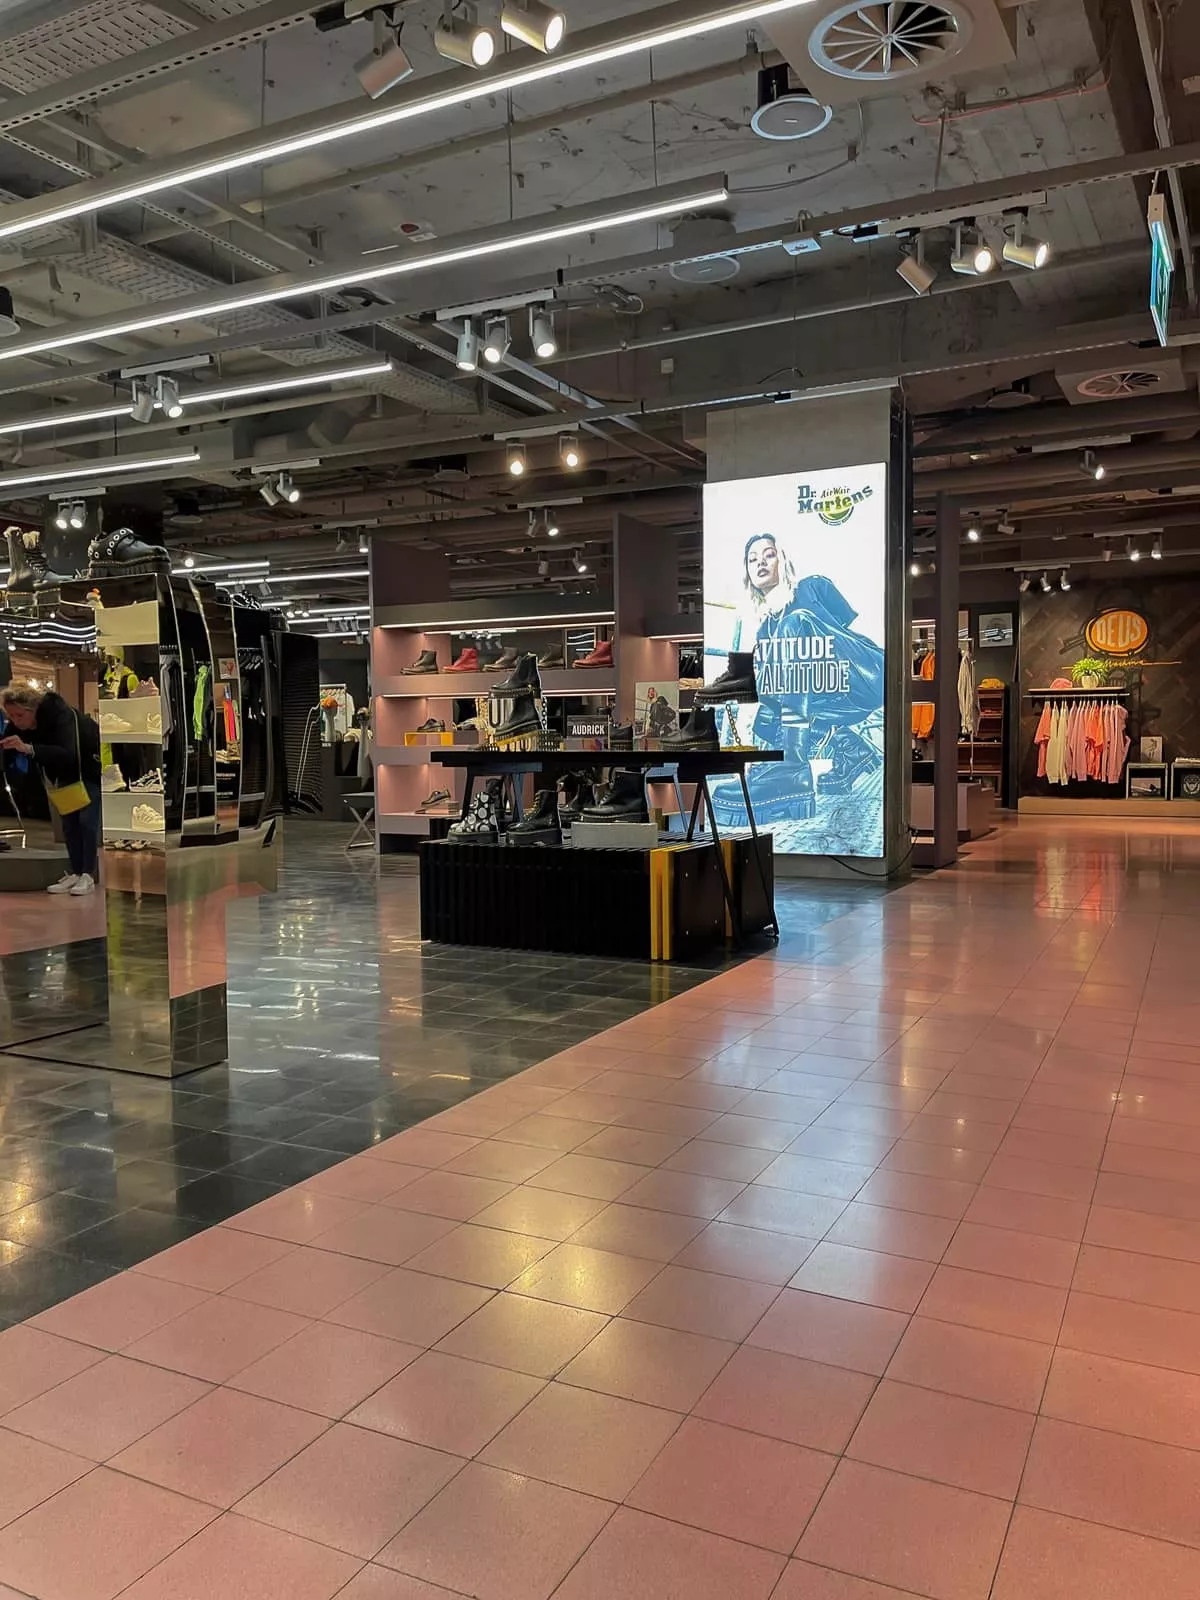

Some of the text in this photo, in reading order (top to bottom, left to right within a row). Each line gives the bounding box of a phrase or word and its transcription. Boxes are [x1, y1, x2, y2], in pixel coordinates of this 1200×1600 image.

[798, 485, 817, 499] Dr.
[798, 485, 873, 514] Martens
[1096, 615, 1141, 647] DEUS
[760, 660, 850, 695] ALTITUDE
[572, 724, 605, 735] AUDRICK
